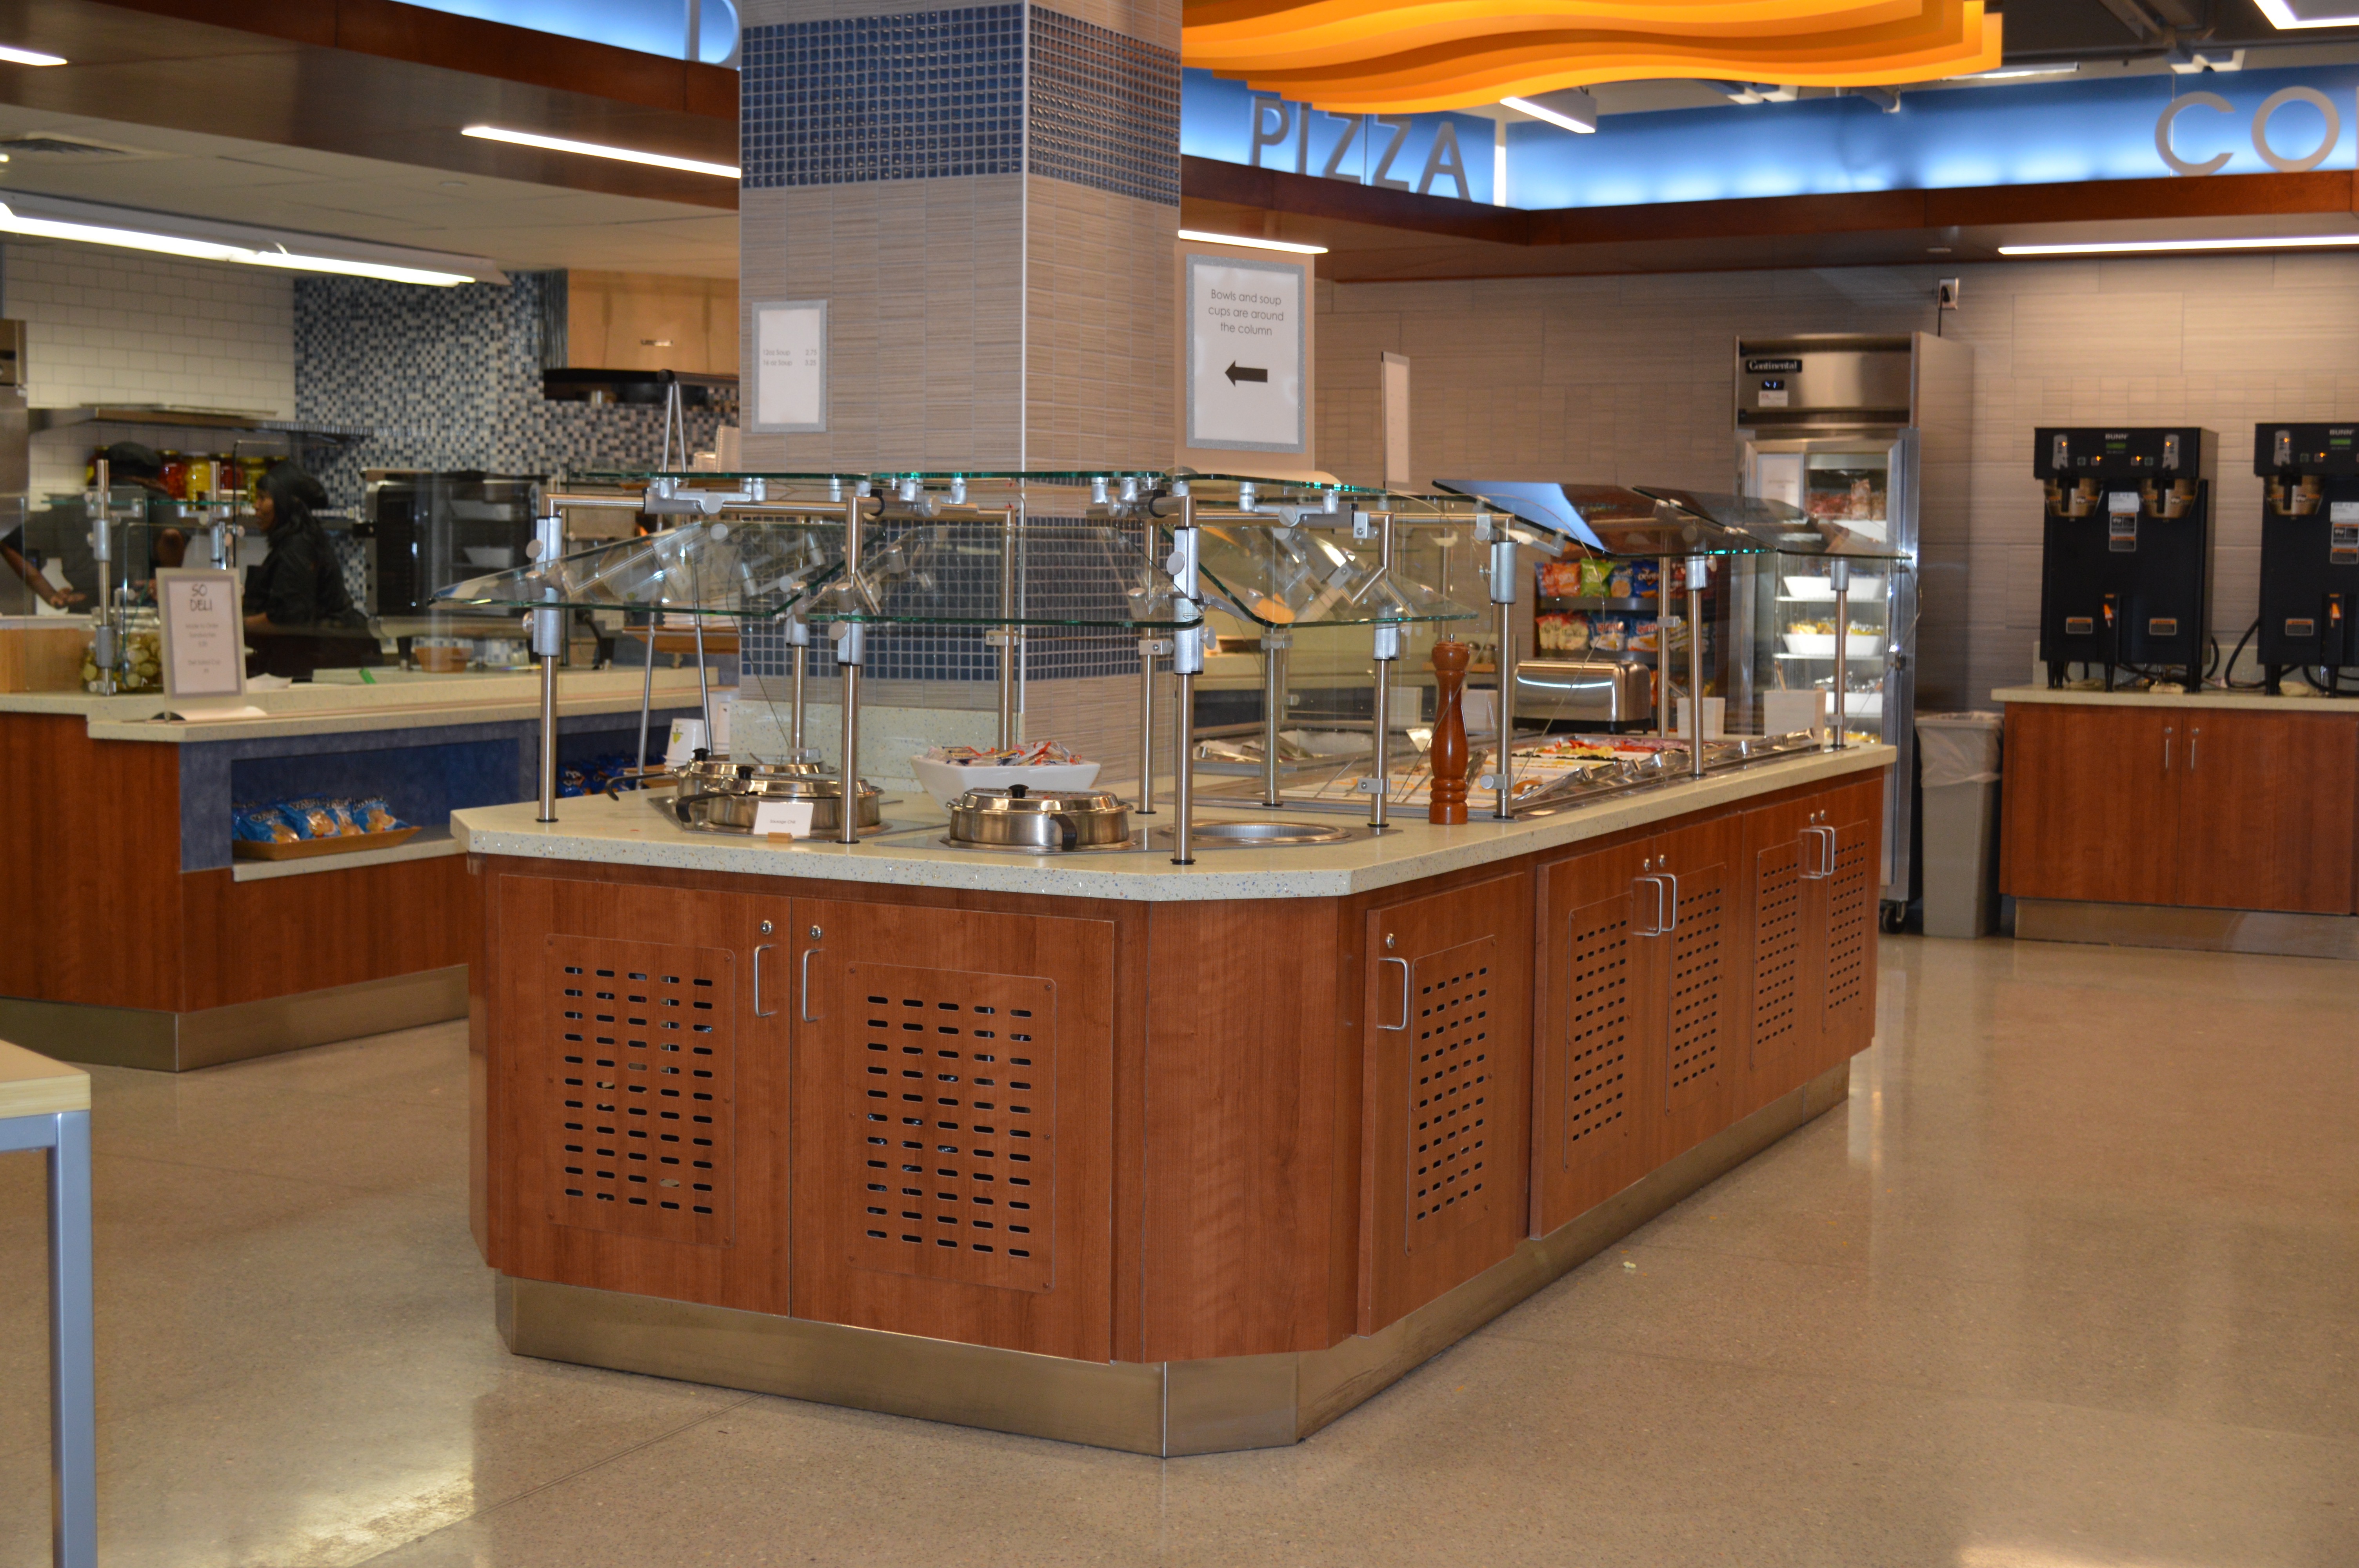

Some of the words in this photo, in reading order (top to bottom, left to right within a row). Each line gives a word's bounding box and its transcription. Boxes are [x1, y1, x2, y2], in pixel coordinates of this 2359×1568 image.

[2155, 86, 2359, 176] CO
[1249, 96, 1472, 202] PIZZA
[1211, 289, 1236, 301] Bowls
[1239, 293, 1257, 303] and
[1259, 295, 1282, 307] soup
[1208, 307, 1230, 318] cups
[1233, 309, 1249, 318] are
[1251, 311, 1284, 321] around
[1220, 322, 1235, 333] the
[1238, 325, 1272, 336] column
[1748, 360, 1797, 371] Continental
[190, 598, 213, 612] DELI
